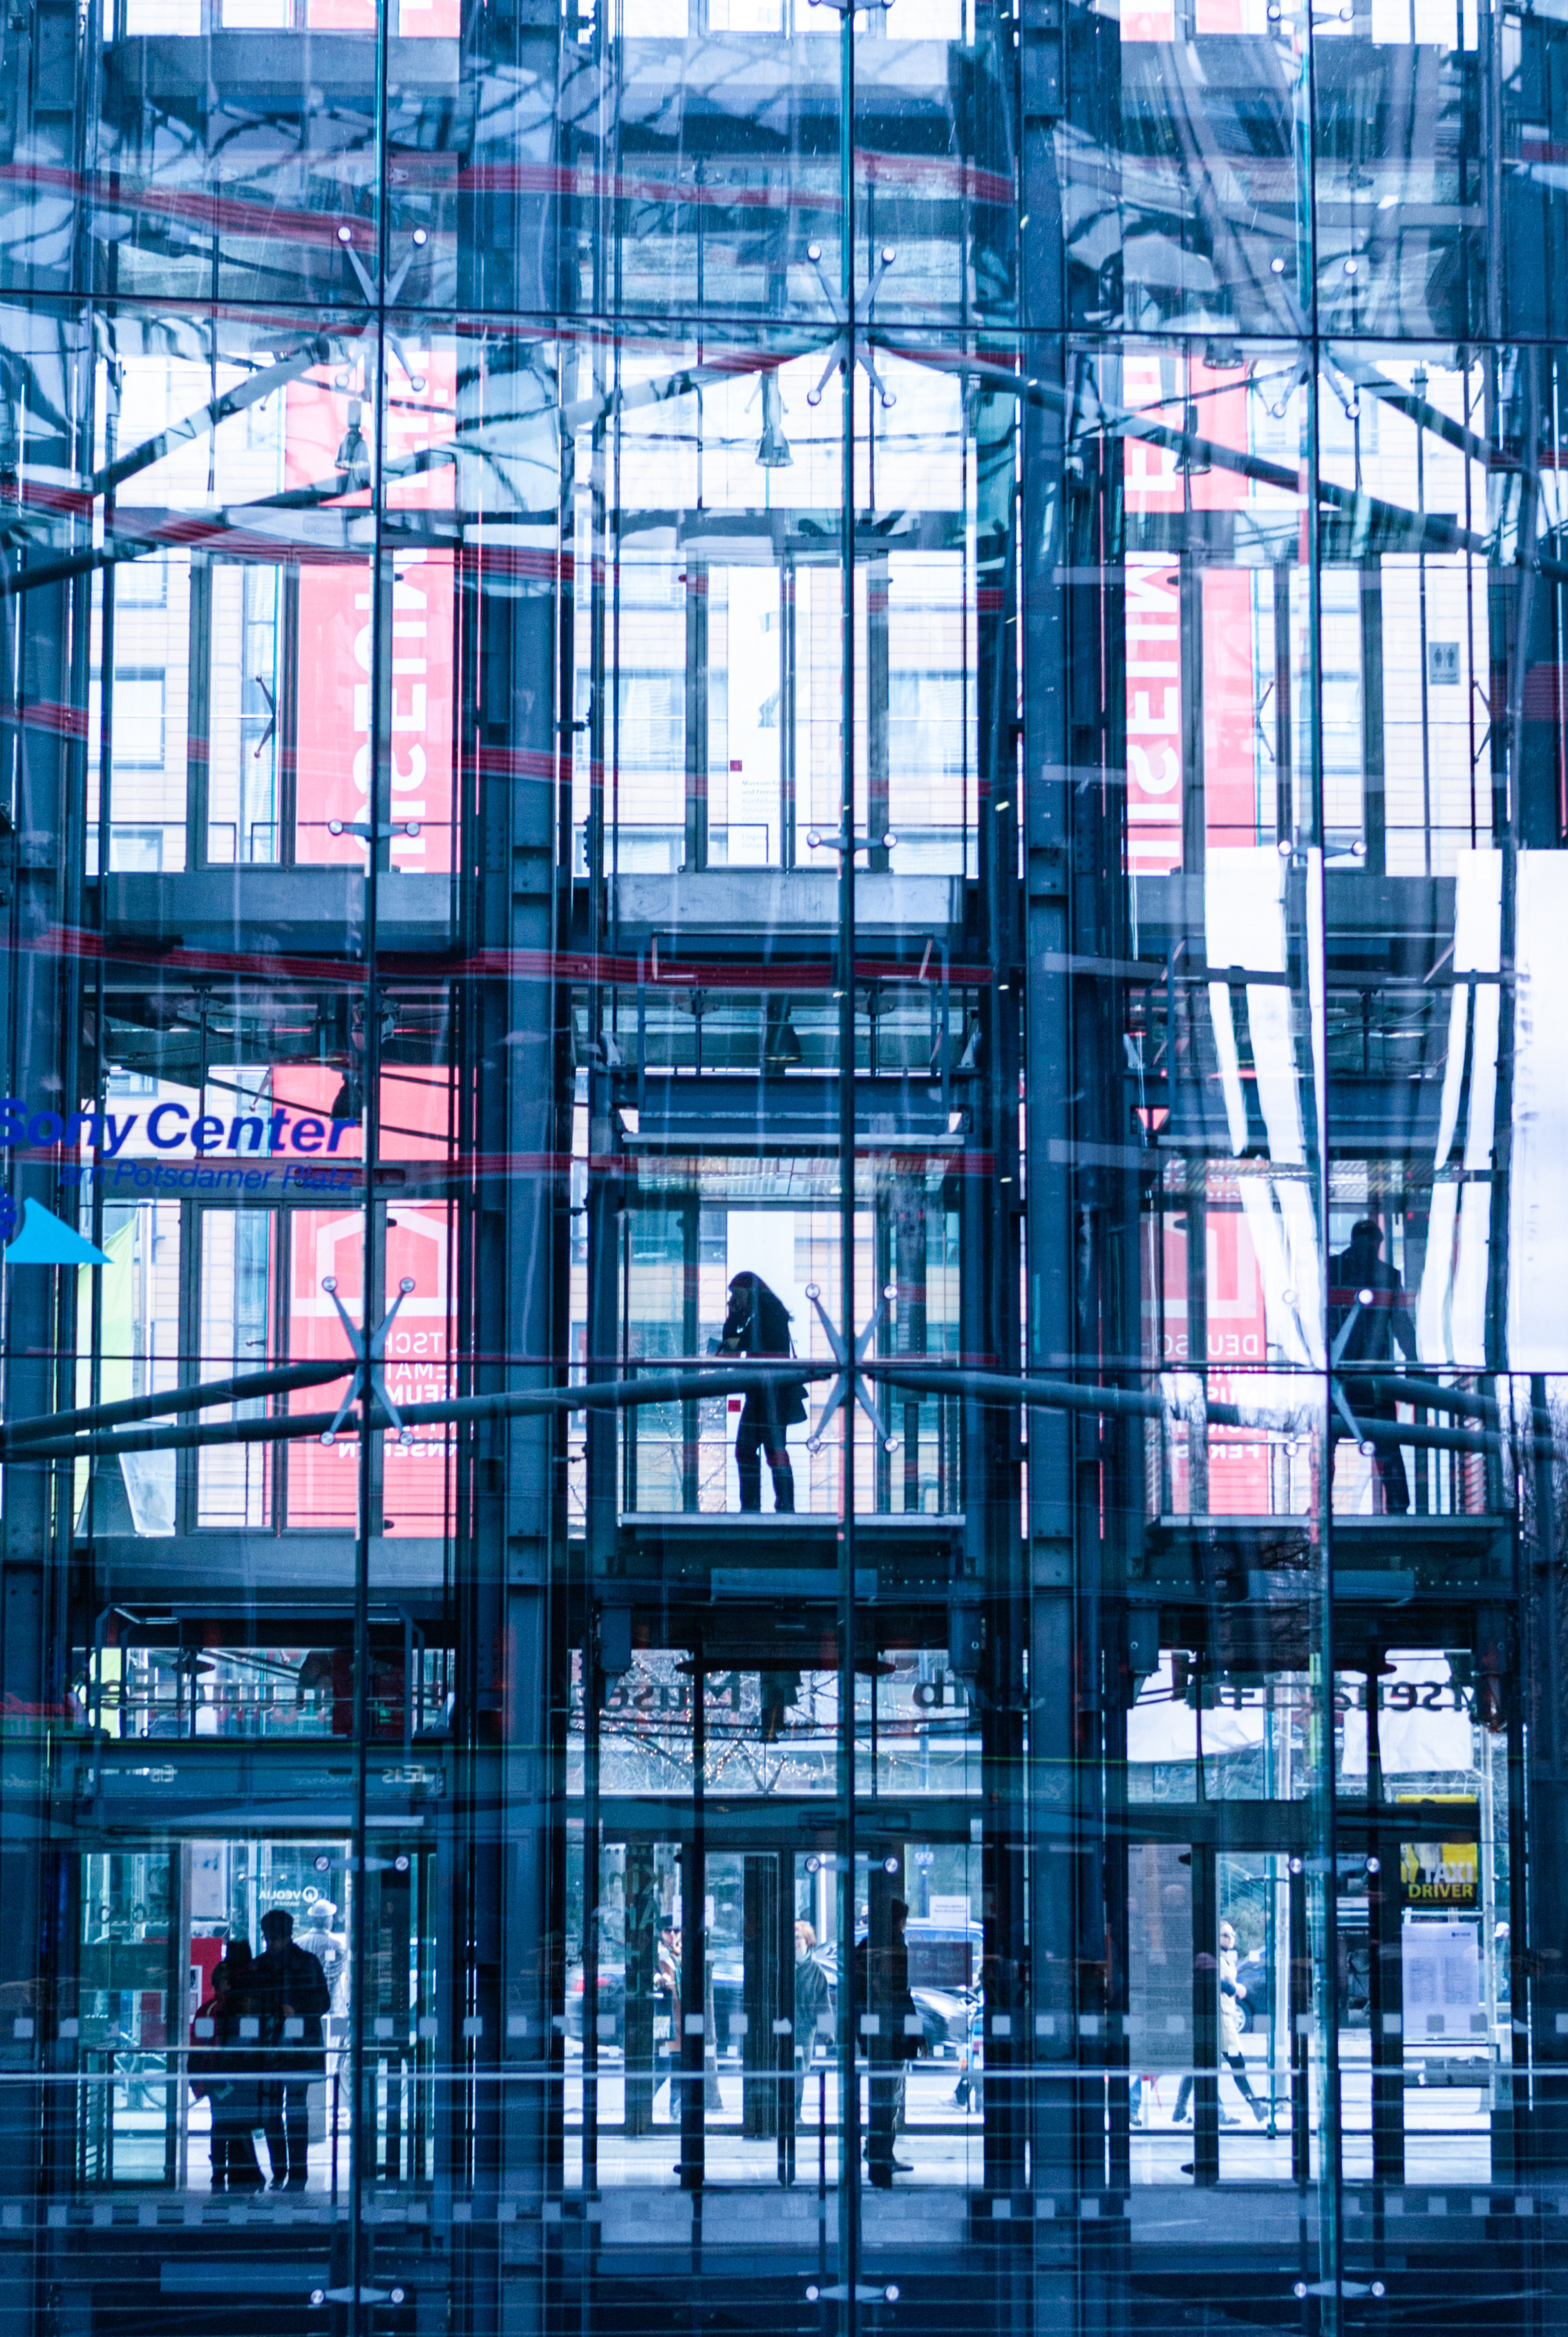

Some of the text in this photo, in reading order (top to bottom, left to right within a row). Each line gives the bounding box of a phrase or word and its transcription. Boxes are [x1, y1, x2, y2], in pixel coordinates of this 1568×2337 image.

[0, 1098, 357, 1158] Sony Center
[59, 1159, 356, 1191] am Potsdamer Platz
[1421, 1861, 1473, 1883] TAXI
[1408, 1884, 1473, 1898] DRIVER
